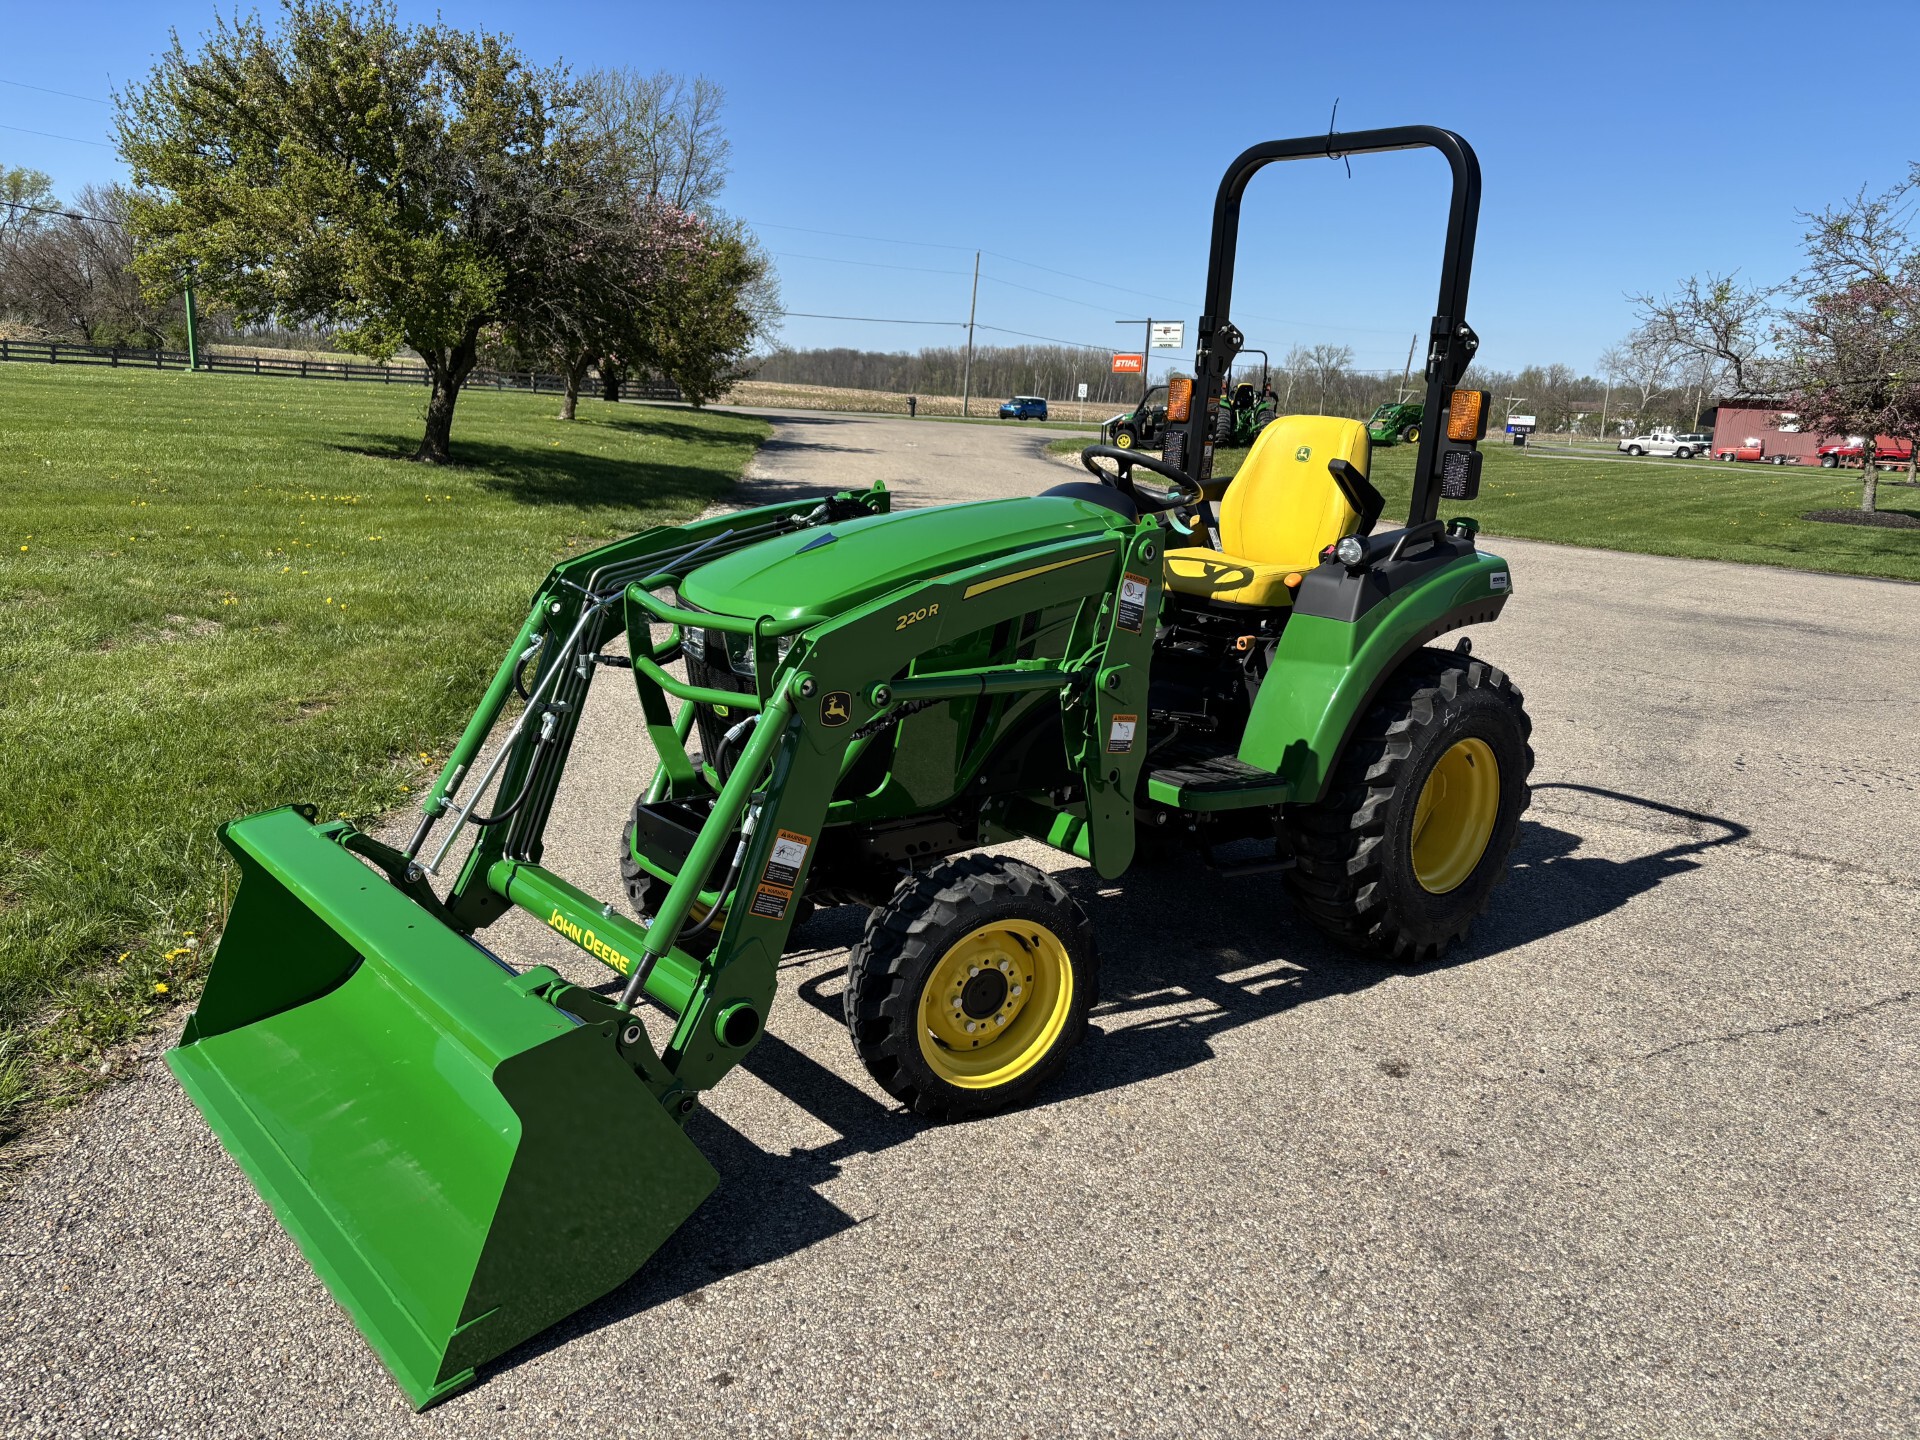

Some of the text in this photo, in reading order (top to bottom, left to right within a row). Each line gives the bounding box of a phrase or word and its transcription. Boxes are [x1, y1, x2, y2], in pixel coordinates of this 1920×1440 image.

[1114, 359, 1139, 367] STIHL
[895, 603, 940, 631] 220 R
[786, 834, 807, 843] WARNING
[767, 887, 788, 897] WARNING
[547, 908, 630, 975] JOHN DEERE
